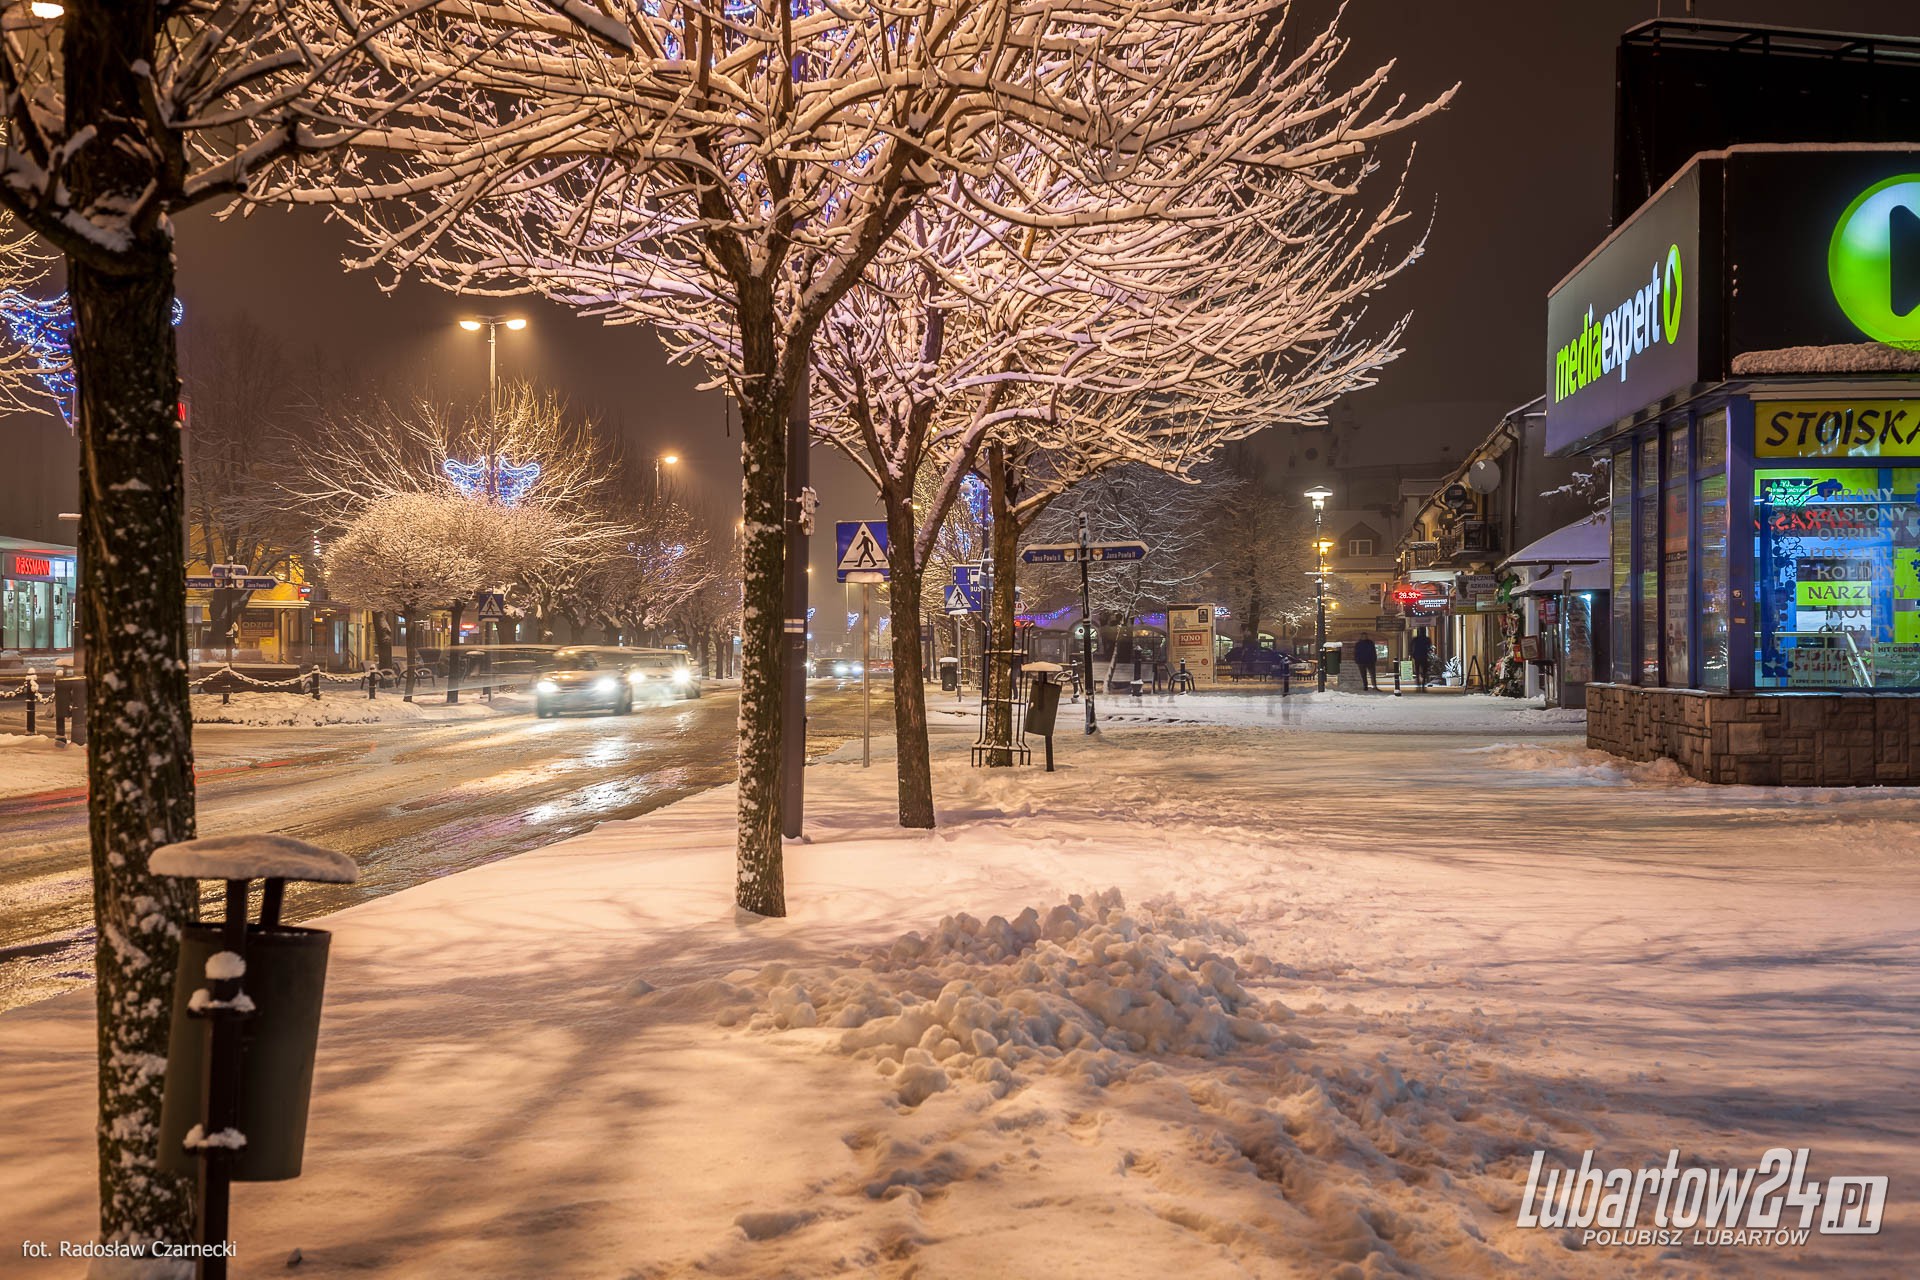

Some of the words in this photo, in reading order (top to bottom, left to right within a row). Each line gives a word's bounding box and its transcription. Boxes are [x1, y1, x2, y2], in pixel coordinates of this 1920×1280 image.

[1823, 488, 1895, 502] FIRANY
[1812, 507, 1907, 522] ZASŁONY
[1818, 526, 1900, 541] OBRUSY
[15, 556, 51, 576] ROSSMANN
[1817, 565, 1897, 580] KOŁDRY
[1808, 585, 1907, 599] NARZUTY
[1180, 634, 1201, 642] KINO
